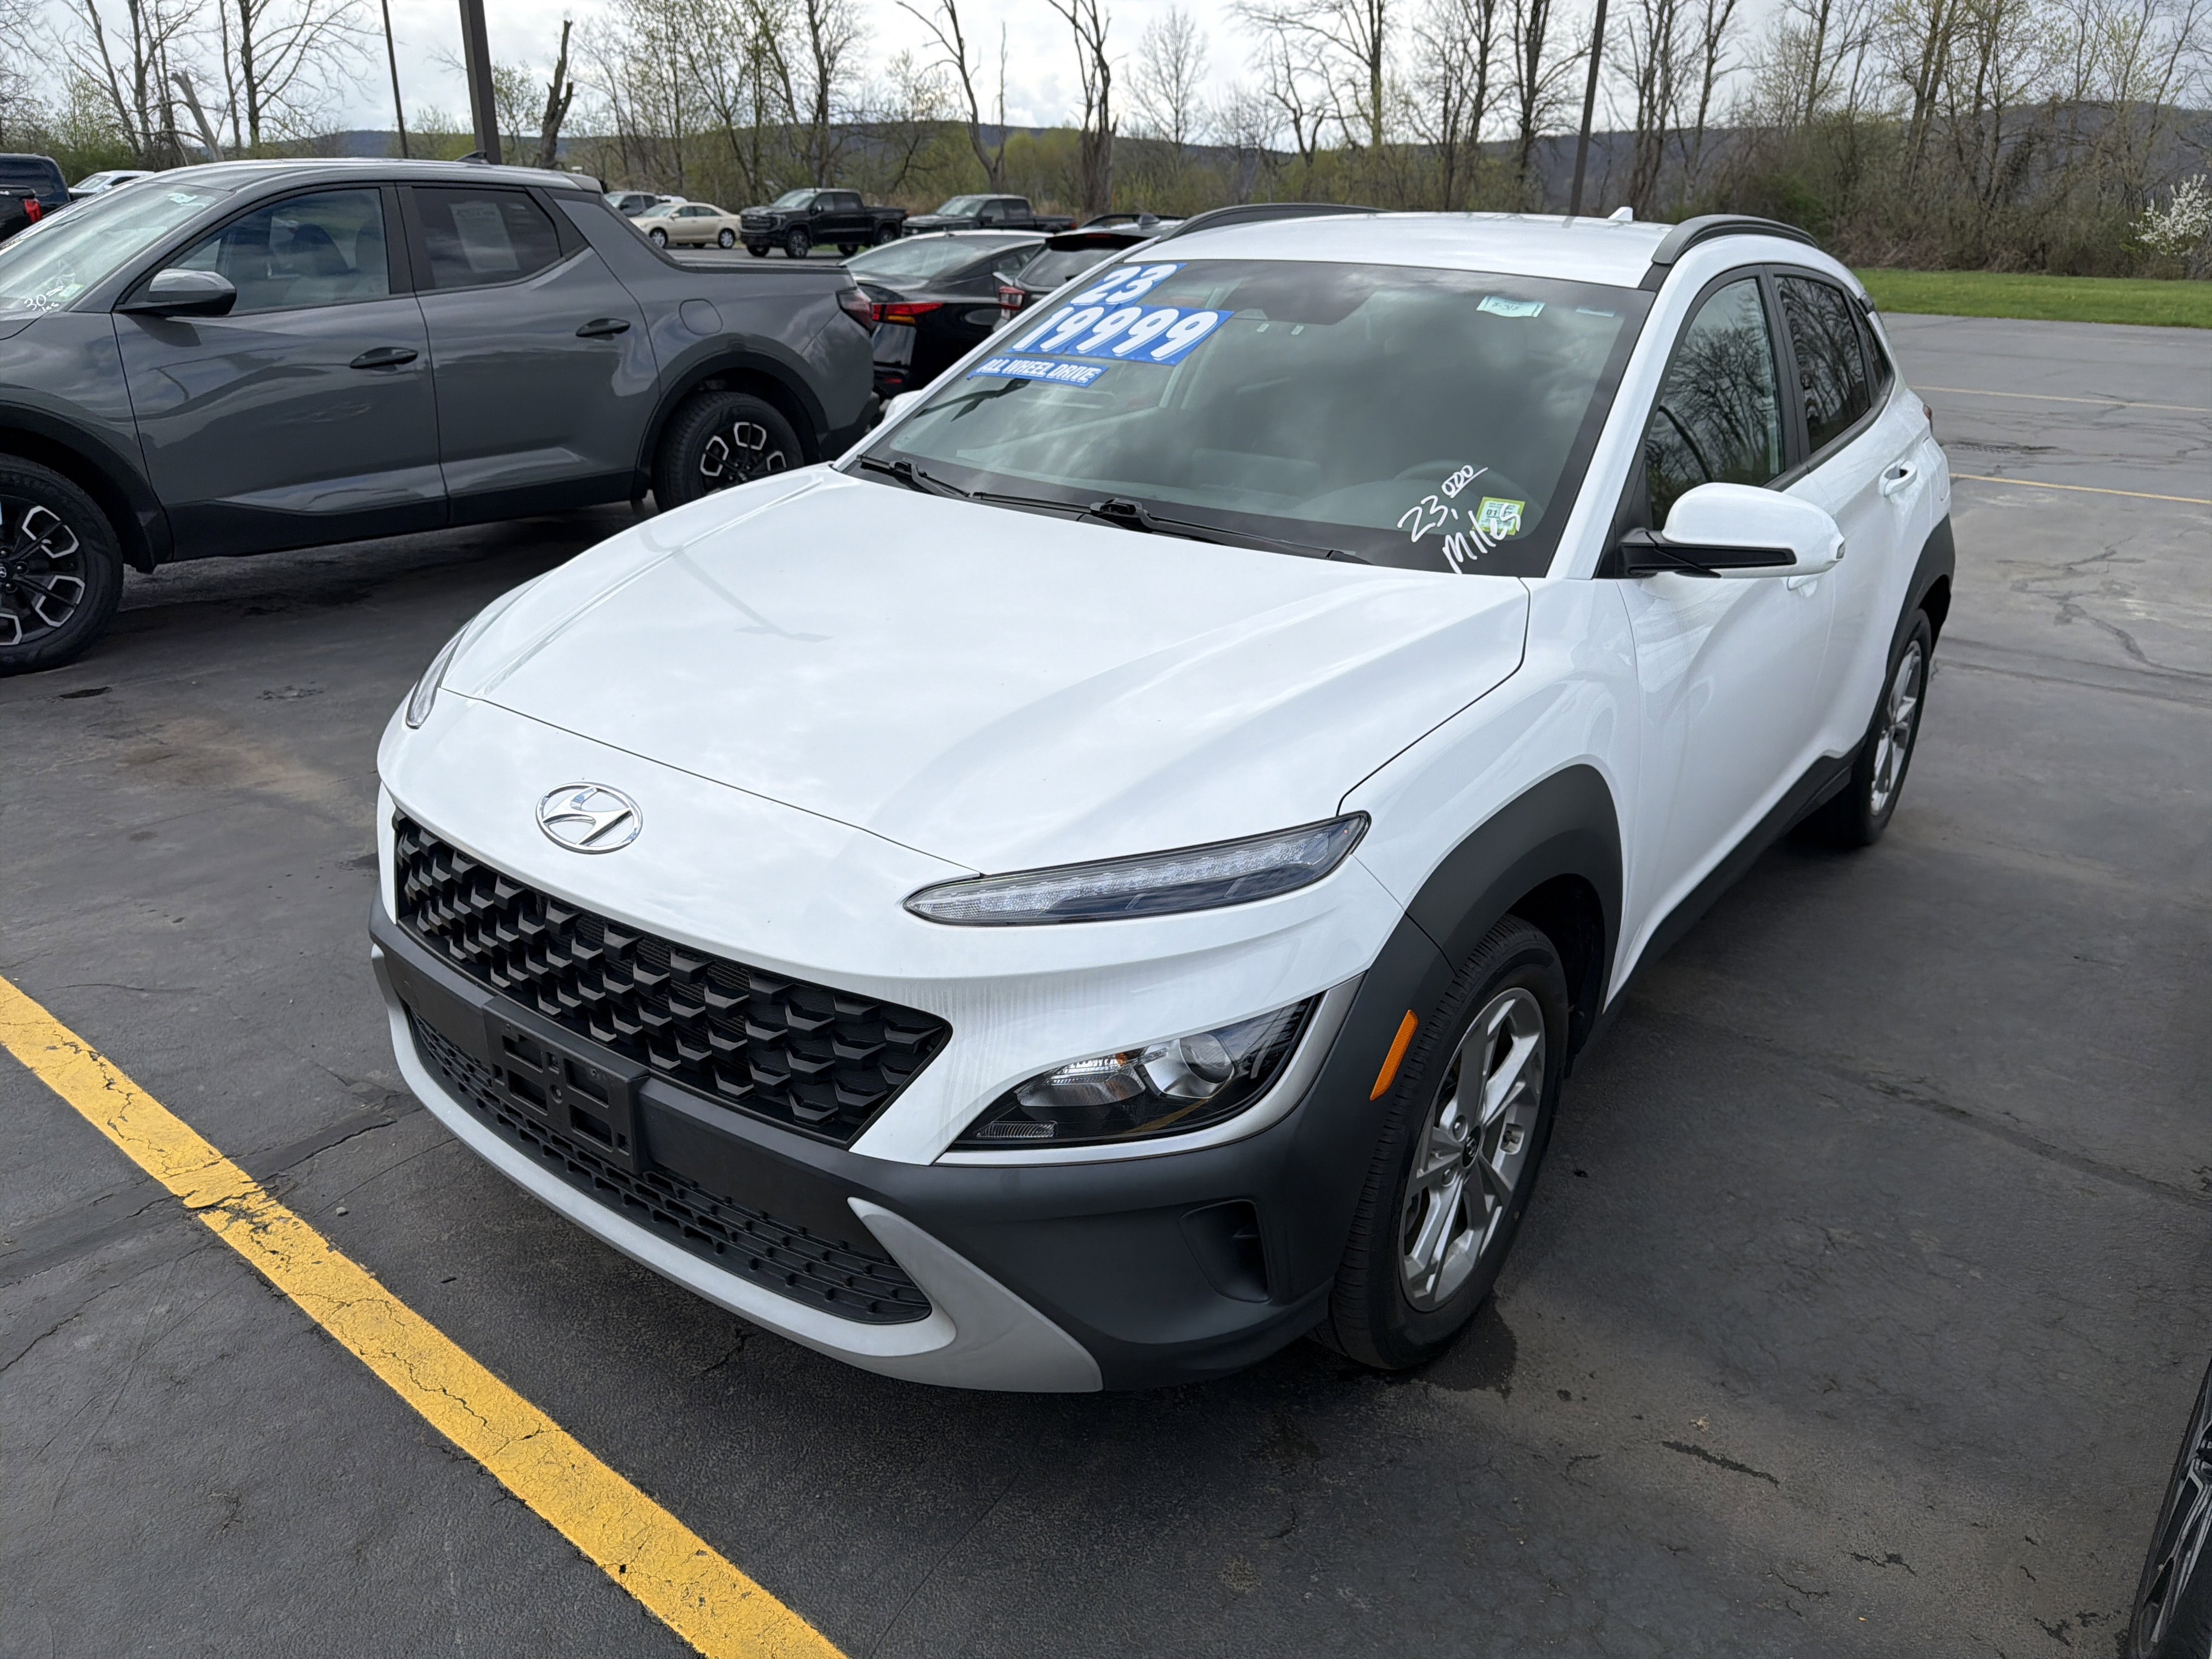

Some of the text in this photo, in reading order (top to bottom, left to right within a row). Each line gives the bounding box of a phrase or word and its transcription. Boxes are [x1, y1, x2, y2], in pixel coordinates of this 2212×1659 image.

[1070, 264, 1178, 306] 23
[1012, 306, 1218, 362] 19999
[975, 358, 1102, 383] ALL WHEEL DRIVE
